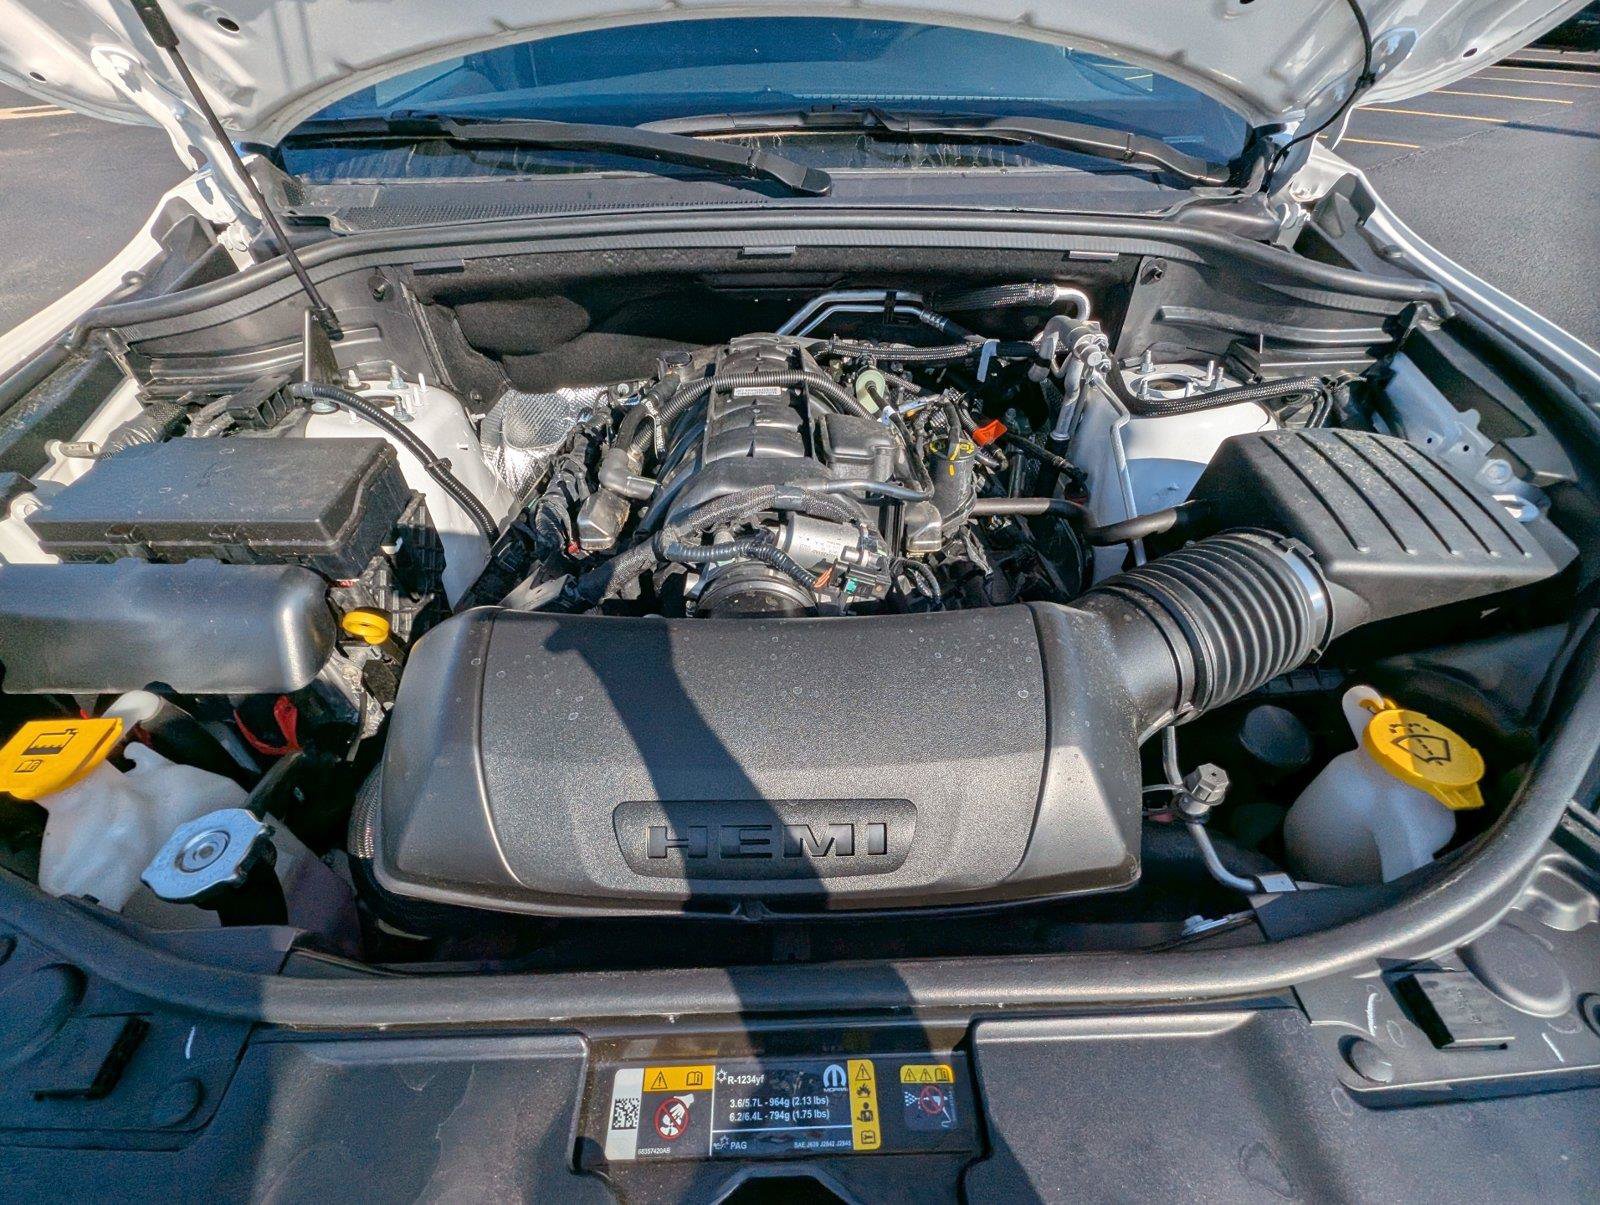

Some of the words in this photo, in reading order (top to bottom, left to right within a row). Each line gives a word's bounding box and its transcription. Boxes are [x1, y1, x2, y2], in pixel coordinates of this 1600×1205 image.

[646, 822, 888, 859] HEMI
[727, 1074, 765, 1086] R-1234yf
[729, 1098, 763, 1108] 3.6/5.7L
[769, 1097, 790, 1108] 964g
[791, 1096, 812, 1107] (2.13
[813, 1095, 829, 1106] lbs)
[729, 1111, 763, 1122] 6.2/6.4L
[769, 1110, 790, 1121] 794g
[792, 1109, 813, 1121] (1.75
[814, 1109, 830, 1120] lbs)
[730, 1141, 748, 1150] PAG
